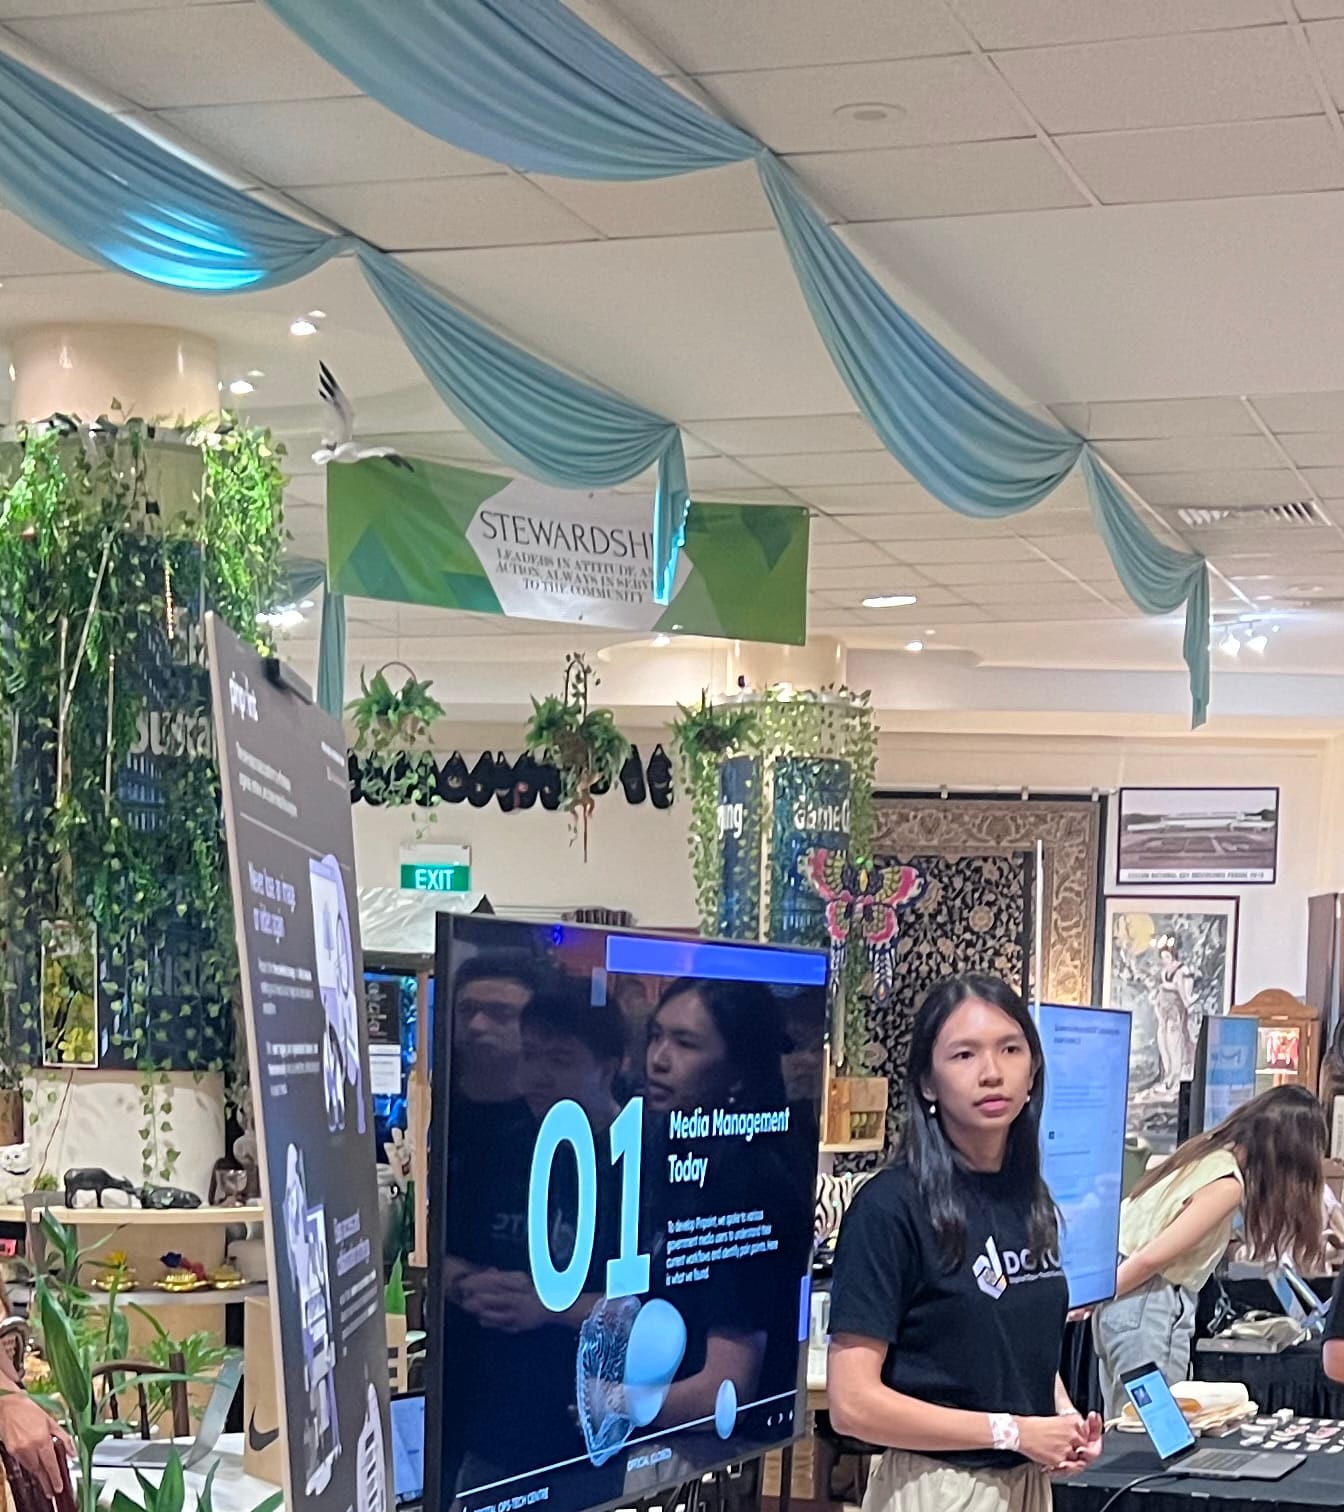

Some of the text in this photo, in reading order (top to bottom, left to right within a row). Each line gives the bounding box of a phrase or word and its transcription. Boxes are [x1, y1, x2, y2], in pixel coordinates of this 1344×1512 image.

[523, 578, 644, 604] TO THE COMMUNITY
[547, 569, 598, 585] ALWAYS
[415, 869, 454, 890] EXIT
[669, 1106, 790, 1142] Media Management
[668, 1151, 708, 1189] Today
[528, 1096, 650, 1312] 01
